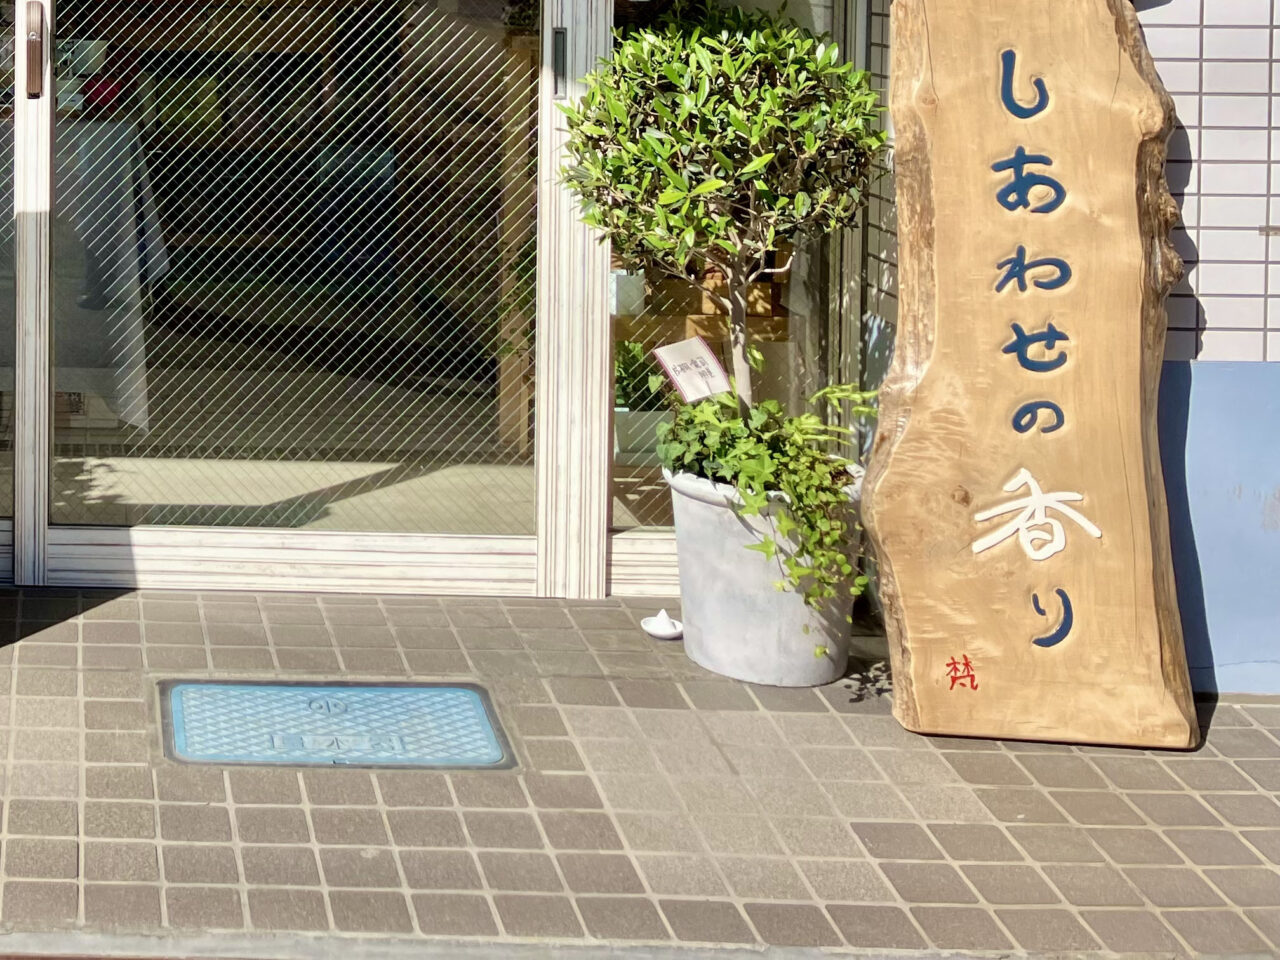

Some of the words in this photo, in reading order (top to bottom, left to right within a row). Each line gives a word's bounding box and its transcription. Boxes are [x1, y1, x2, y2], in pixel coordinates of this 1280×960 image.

[971, 48, 1103, 649] しあわせの香り
